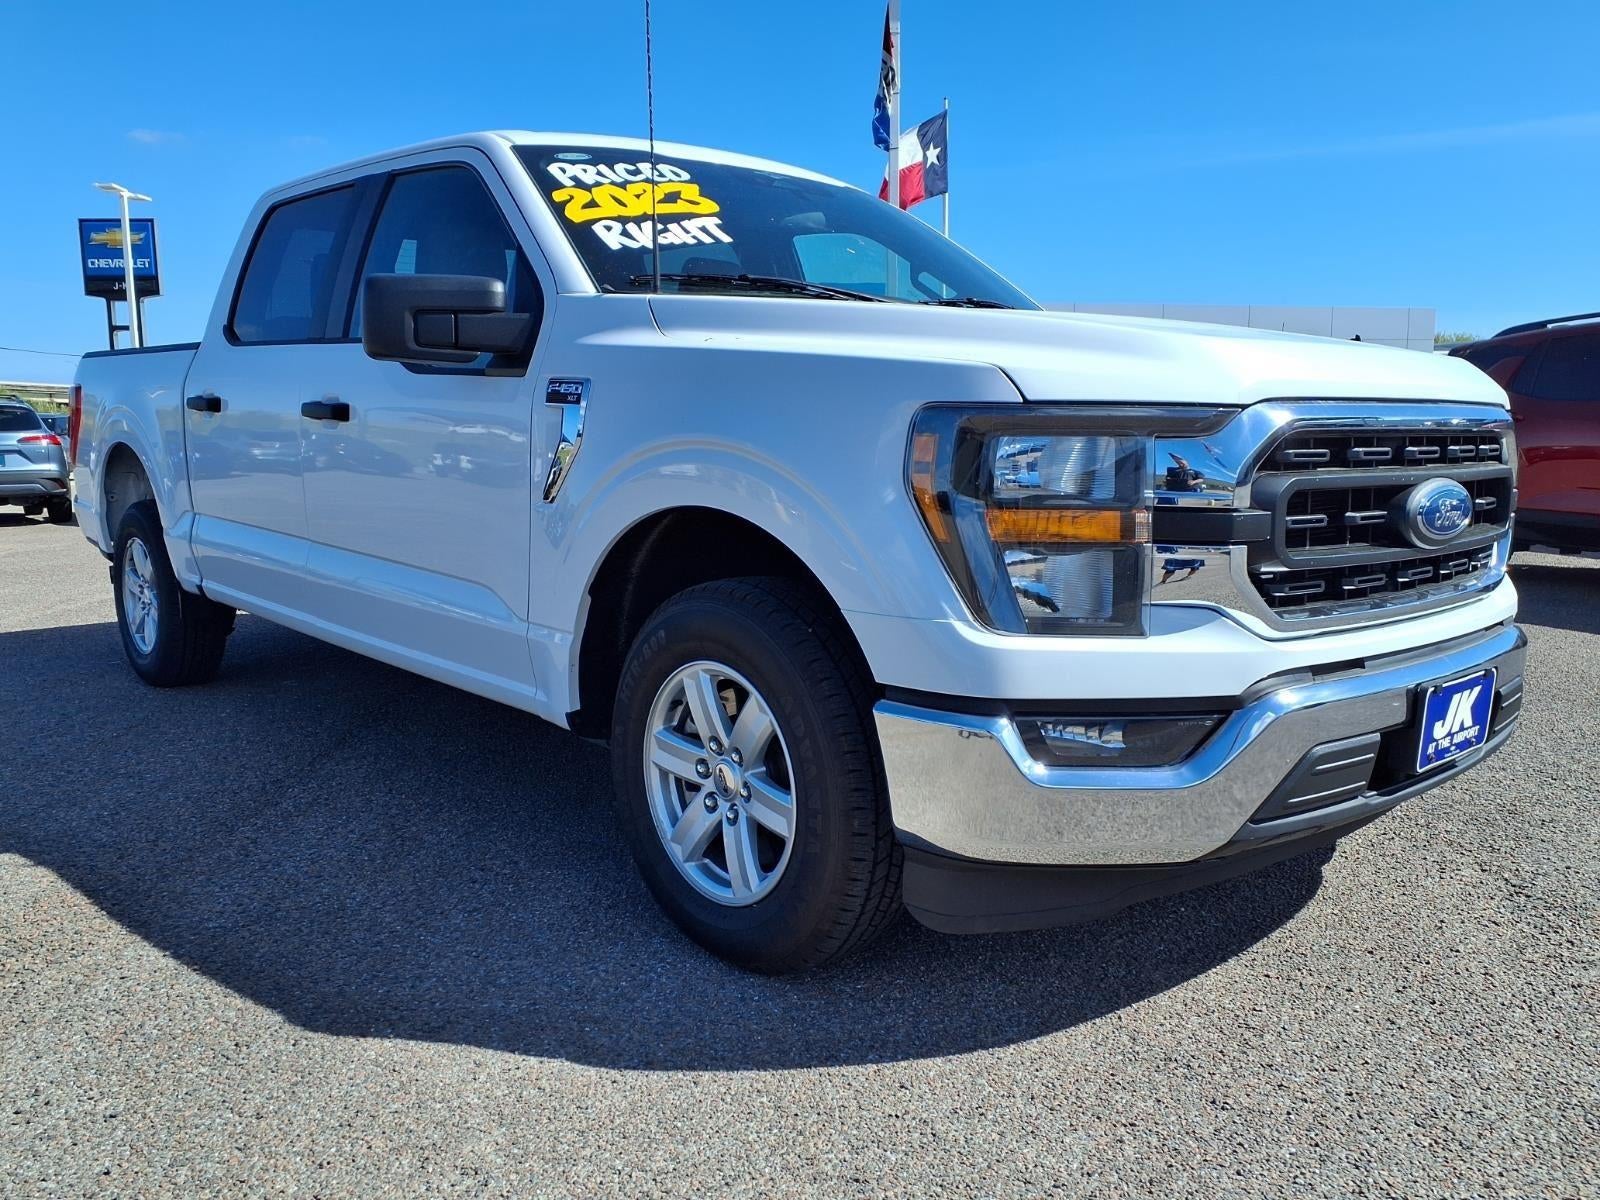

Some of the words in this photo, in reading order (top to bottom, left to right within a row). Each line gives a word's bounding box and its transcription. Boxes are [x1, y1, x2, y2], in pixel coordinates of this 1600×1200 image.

[546, 162, 691, 187] PRICED
[551, 182, 720, 223] 2023
[591, 217, 734, 250] RIGHT
[87, 258, 151, 268] CHEVRLET
[548, 383, 583, 394] F-150
[1435, 498, 1465, 528] Ford
[1433, 684, 1483, 740] JK
[1427, 741, 1437, 755] AT
[1438, 736, 1451, 750] THE
[1452, 726, 1480, 744] AIRPORT
